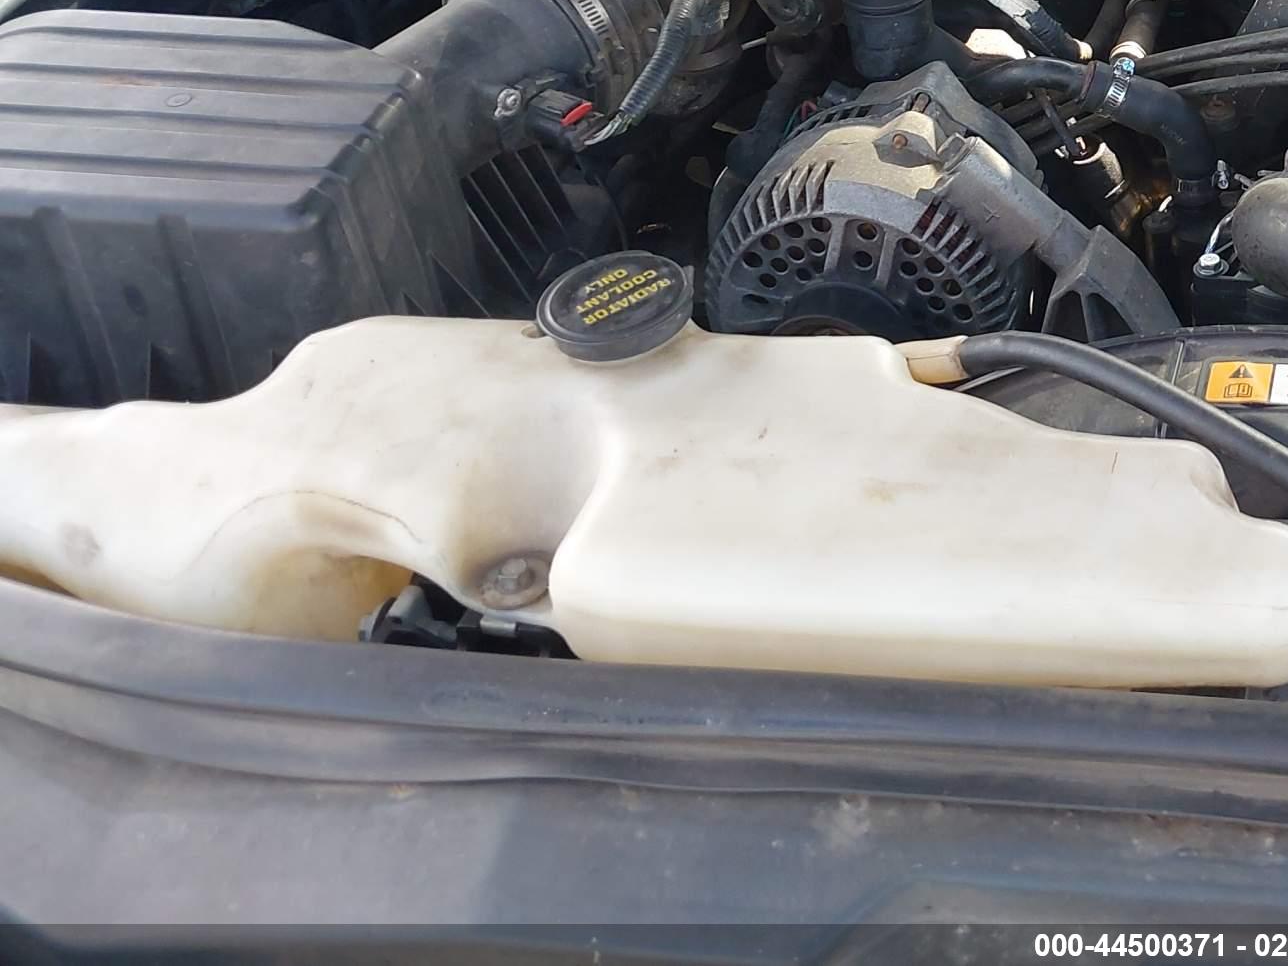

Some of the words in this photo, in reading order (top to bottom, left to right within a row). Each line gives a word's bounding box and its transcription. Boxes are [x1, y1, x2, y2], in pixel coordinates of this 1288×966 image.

[575, 269, 658, 314] COOLANT
[582, 278, 672, 325] RADIATOR
[584, 268, 629, 294] ONLY
